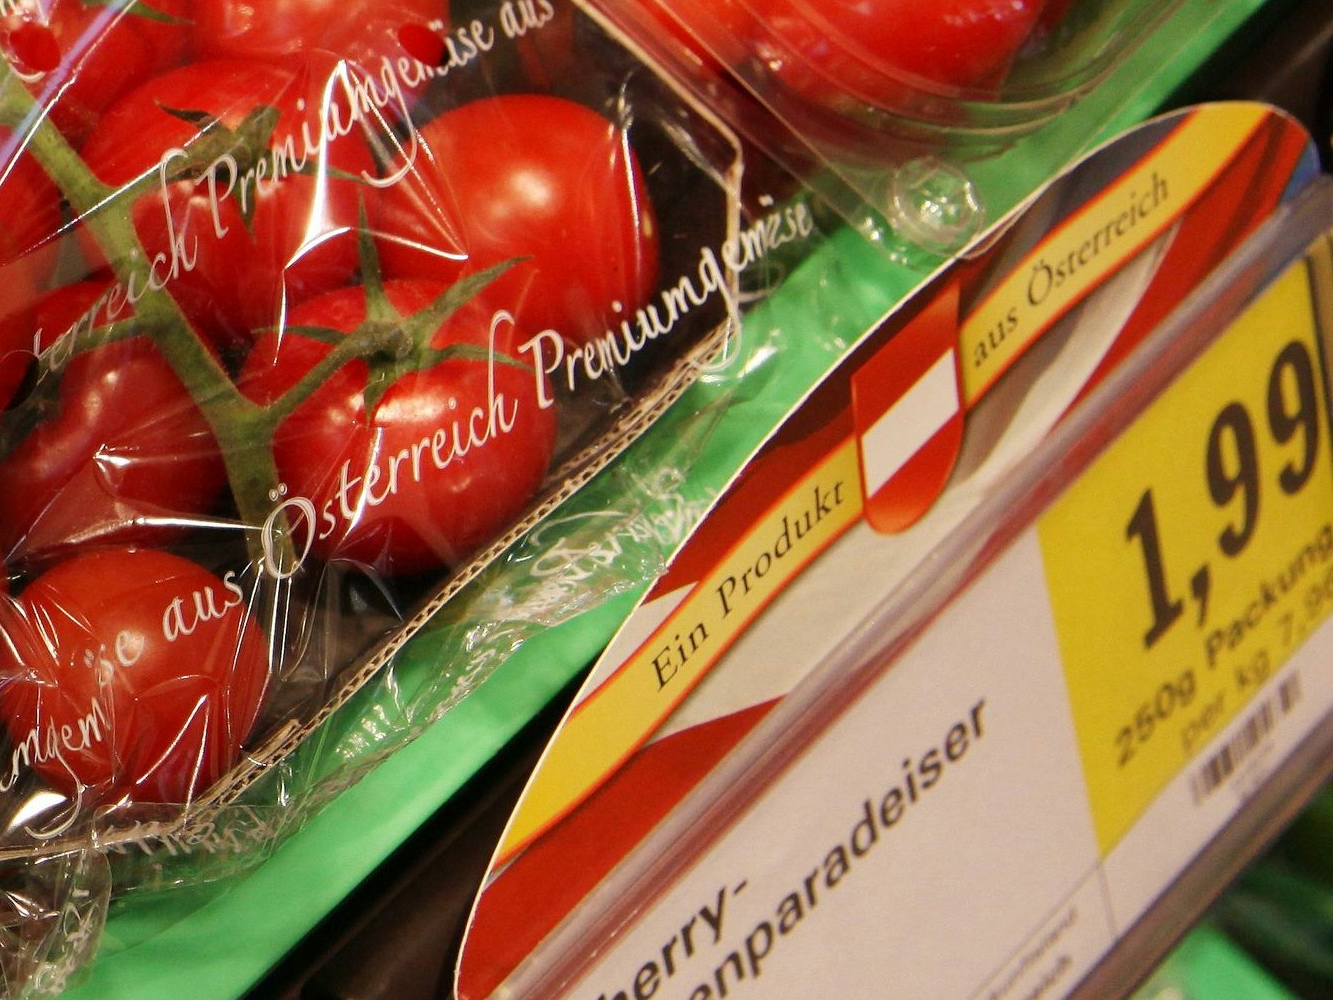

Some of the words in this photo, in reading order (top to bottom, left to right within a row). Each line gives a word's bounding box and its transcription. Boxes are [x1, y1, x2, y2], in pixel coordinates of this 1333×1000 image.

[160, 569, 245, 643] aus
[259, 309, 519, 582] Österreich
[649, 620, 711, 693] Ein
[714, 477, 846, 620] Produkt
[972, 310, 1019, 369] aus
[1026, 172, 1170, 308] Österreich
[1125, 340, 1321, 651] 1,99
[1113, 667, 1197, 769] 250g
[1180, 692, 1227, 757] per
[1234, 647, 1273, 698] kg
